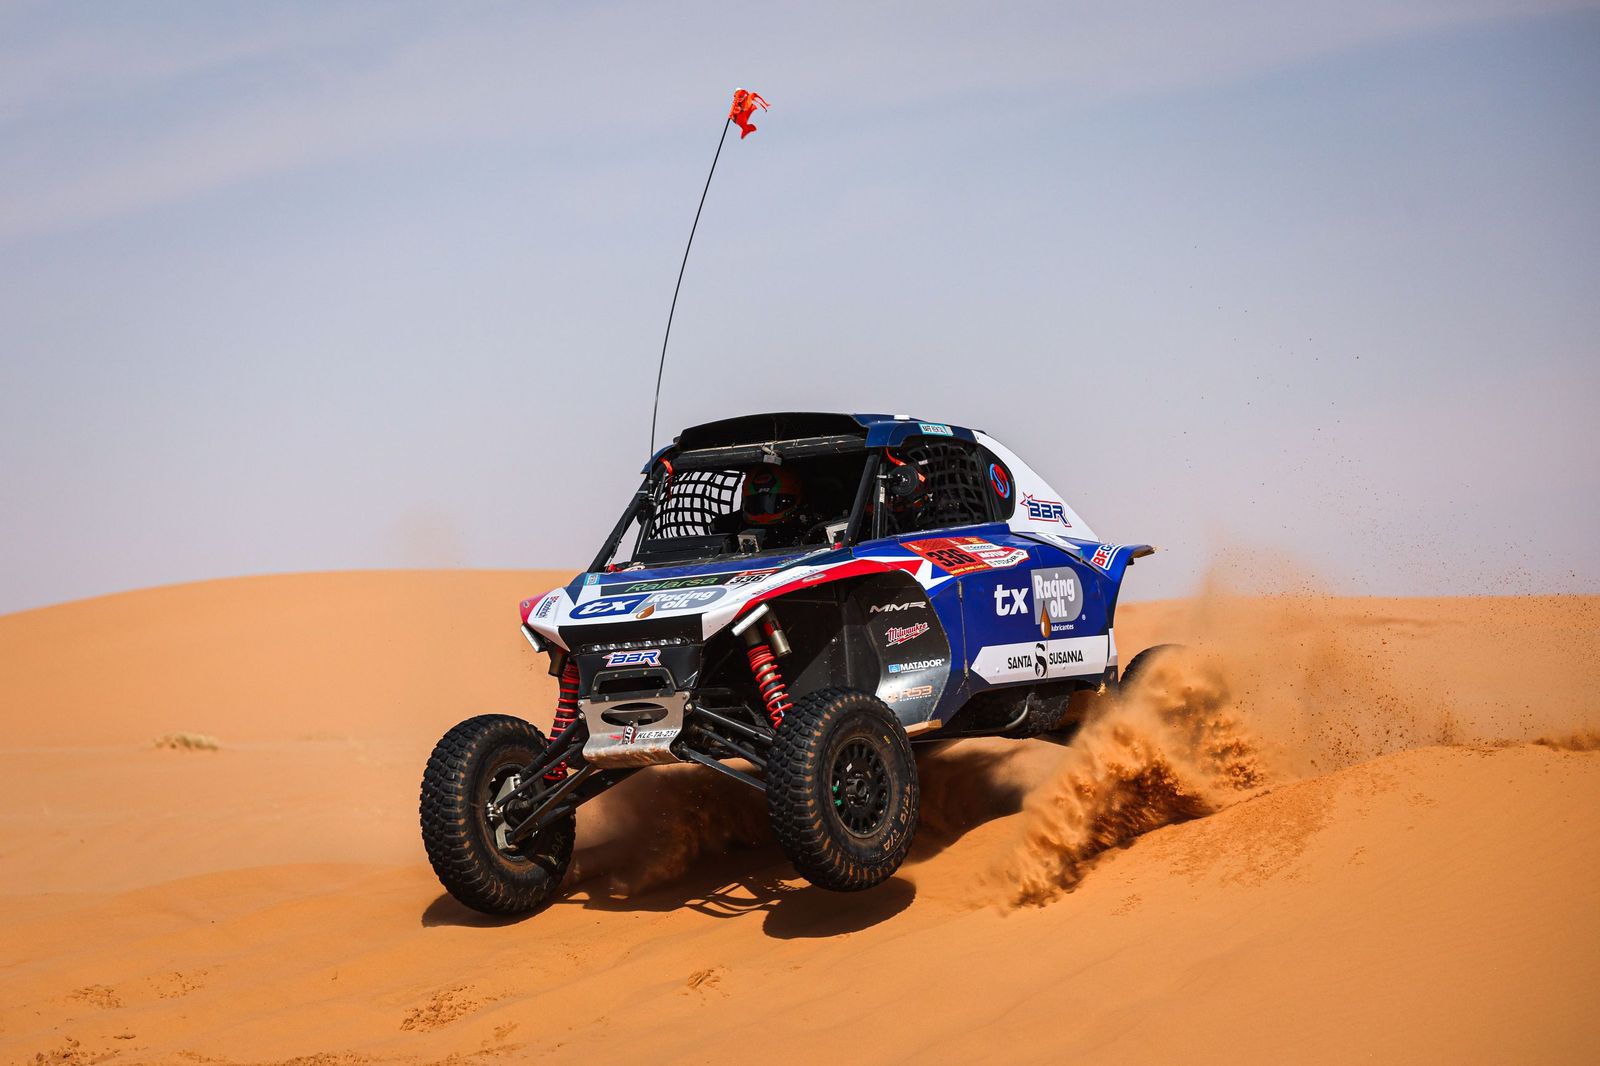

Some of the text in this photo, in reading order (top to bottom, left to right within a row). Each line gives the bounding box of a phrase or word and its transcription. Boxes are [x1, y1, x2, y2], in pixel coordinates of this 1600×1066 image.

[1027, 500, 1070, 527] BBR
[926, 548, 977, 567] 336
[625, 578, 718, 592] Ralarsa
[729, 574, 768, 584] 336
[1033, 573, 1075, 602] Racing
[647, 590, 717, 603] Racing
[994, 584, 1029, 616] tx
[578, 598, 639, 616] tx
[870, 601, 927, 613] MMR
[885, 622, 928, 642] Milwaukee
[1051, 624, 1074, 632] lubricantes
[611, 652, 658, 664] BBR
[900, 659, 942, 671] MATADOR
[1008, 650, 1084, 669] SANTA SUSANNA
